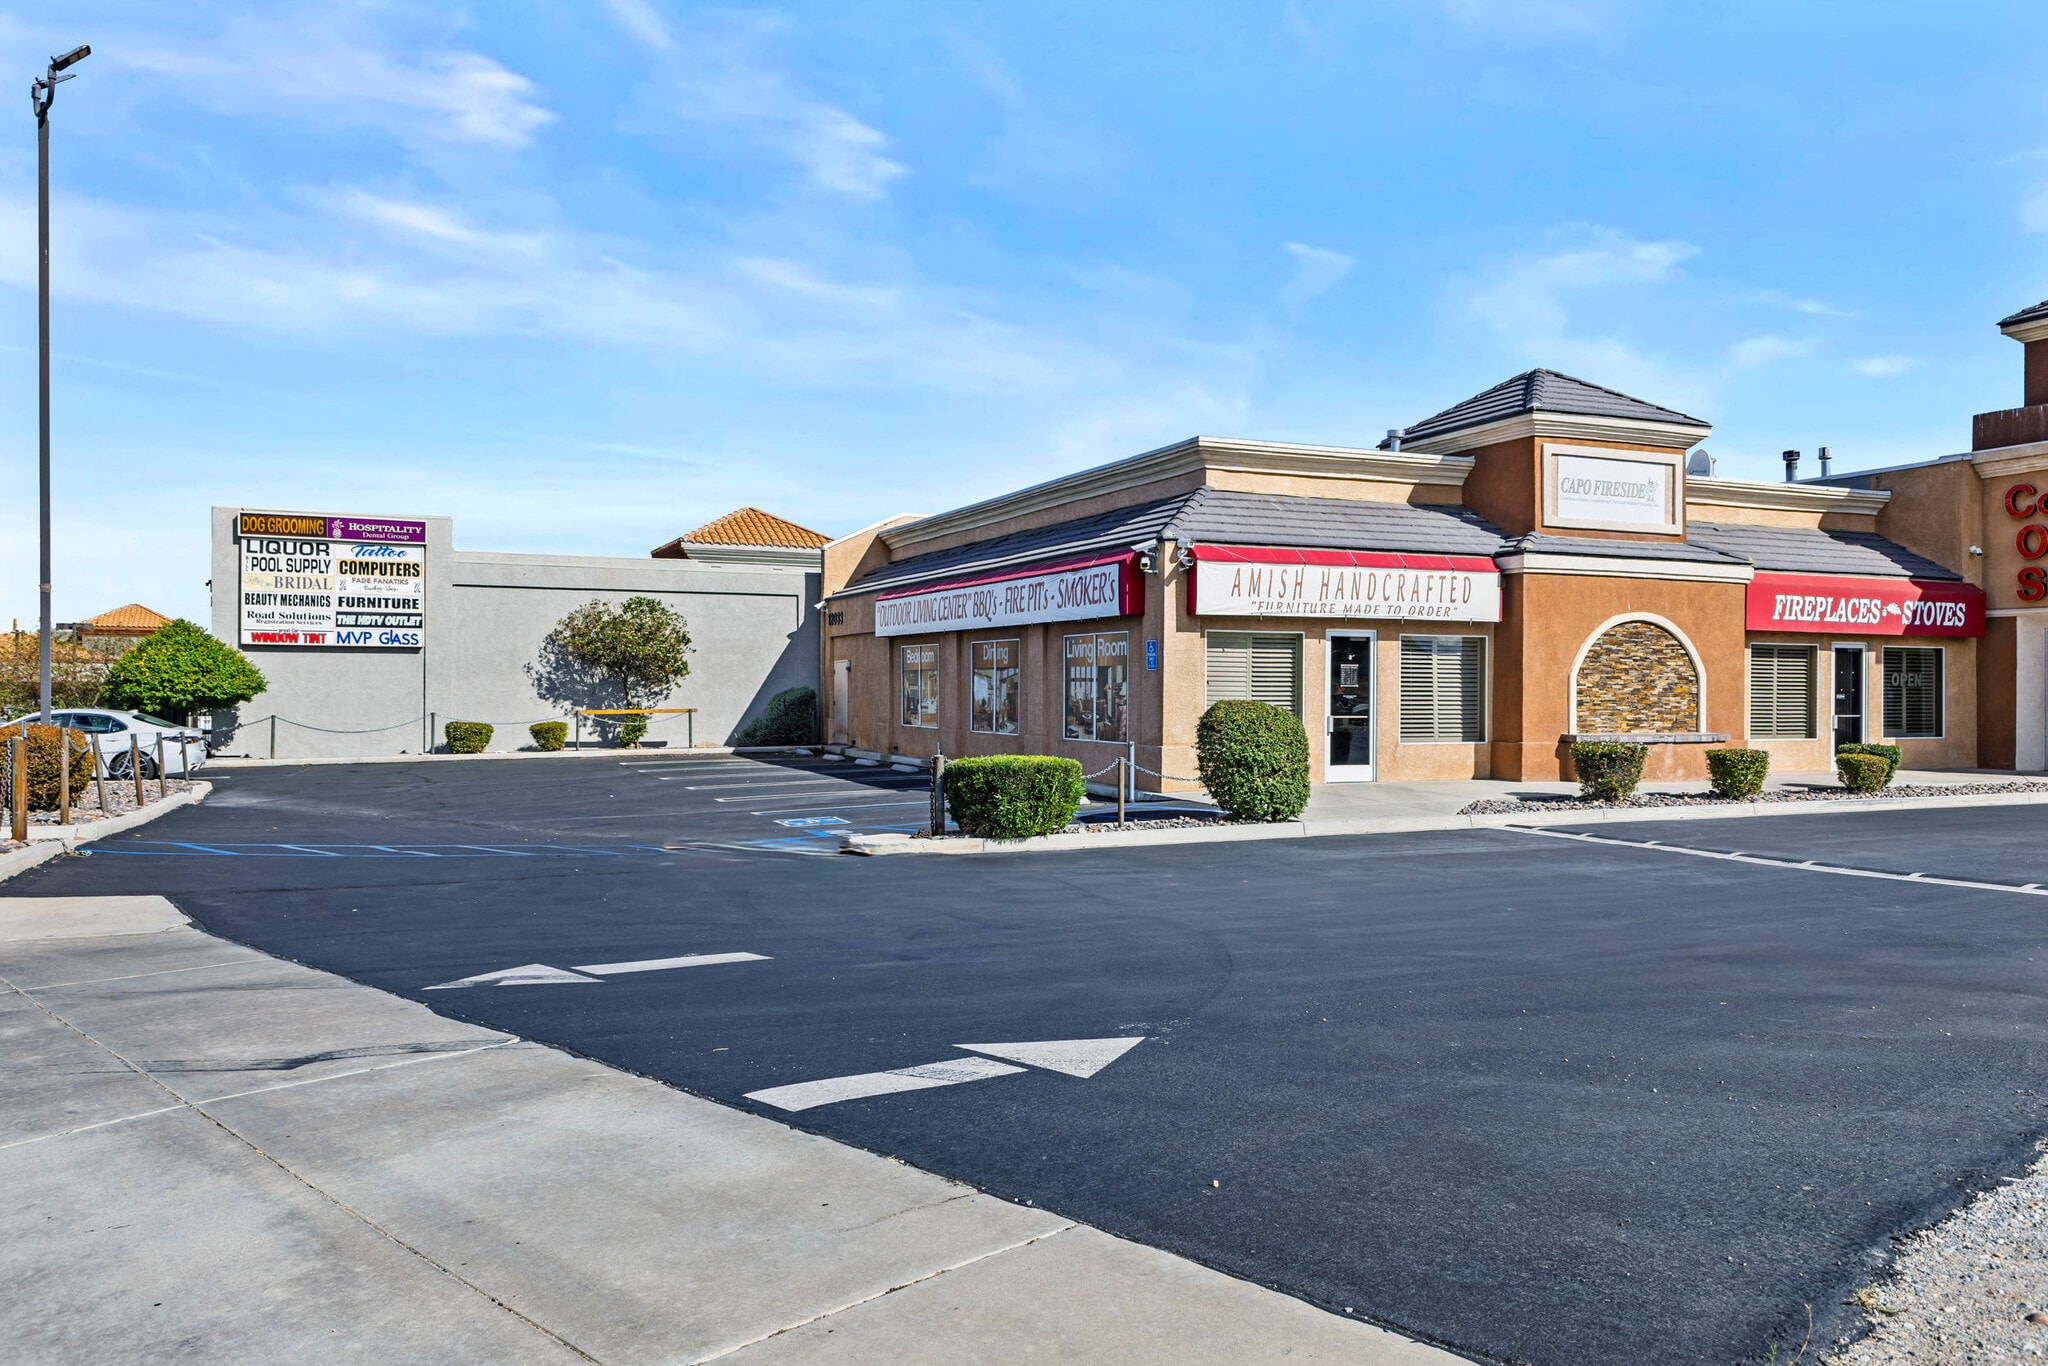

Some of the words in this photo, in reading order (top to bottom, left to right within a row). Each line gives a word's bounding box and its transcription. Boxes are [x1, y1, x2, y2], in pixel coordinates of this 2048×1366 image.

[1560, 477, 1592, 496] CAPO
[1593, 480, 1646, 499] FIRESIDE
[242, 516, 266, 532] DOG
[268, 518, 324, 535] GROOMING
[348, 522, 422, 534] HOSPITALITY
[386, 532, 410, 540] Group
[246, 540, 330, 556] LIQUOR
[350, 544, 406, 558] Tattoo
[252, 556, 282, 572] POOL
[286, 558, 331, 574] SUPPLY
[340, 560, 420, 578] COMPUTERS
[274, 576, 332, 590] BRIDAL
[1231, 567, 1304, 600] AMISH
[1319, 568, 1472, 604] HANDCRAFTED
[2017, 567, 2048, 601] S
[244, 592, 278, 606] BEAUTY
[280, 594, 331, 608] MECHANICS
[338, 596, 420, 610] FURNITURE
[912, 598, 936, 624] LIVING
[972, 589, 998, 622] BBQ's
[1004, 583, 1026, 614] FIRE
[1027, 581, 1048, 612] PIT's
[1057, 572, 1116, 609] SMOKER's
[247, 610, 274, 619] Road
[278, 612, 332, 620] Solutions
[1342, 604, 1380, 614] MADE
[1388, 604, 1402, 615] TO
[1772, 594, 1882, 624] FIREPLACES
[1902, 600, 1966, 627] STOVES
[336, 614, 356, 626] THE
[357, 615, 385, 626] HDTV
[384, 616, 422, 626] OUTLET
[251, 632, 299, 644] WINDOW
[302, 633, 327, 644] TINT
[336, 631, 372, 644] MVP
[1066, 640, 1094, 664] Living
[1098, 639, 1127, 658] Room
[1892, 672, 1922, 686] OPEN
